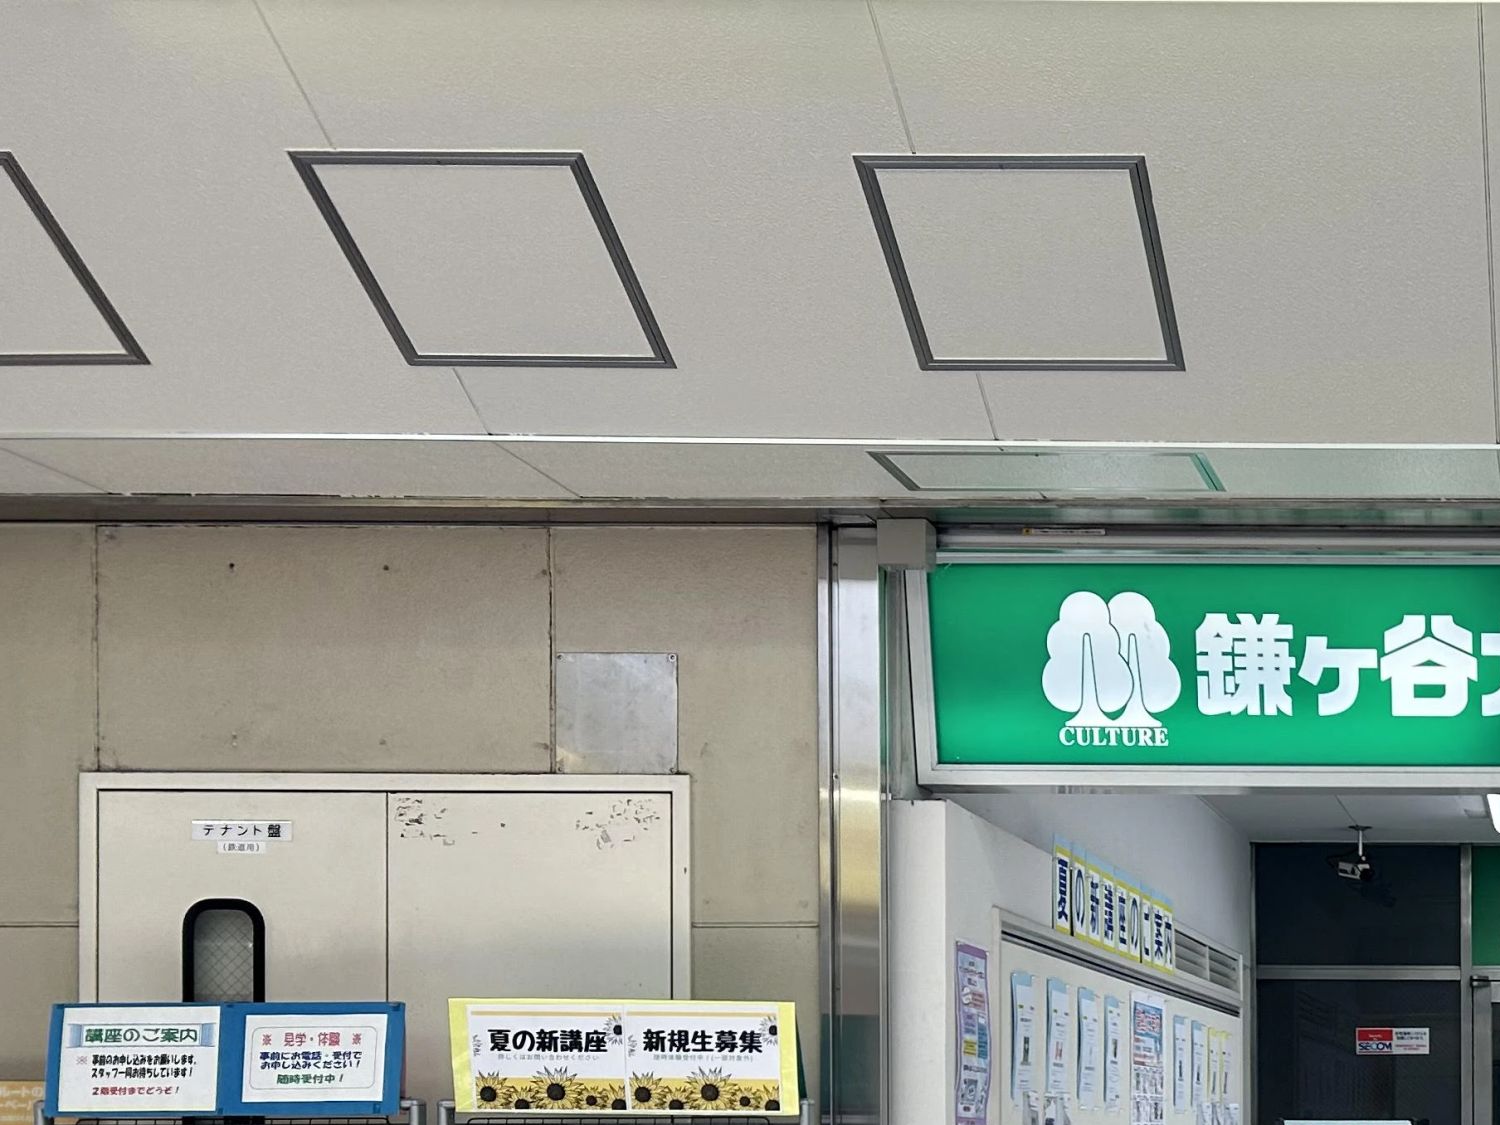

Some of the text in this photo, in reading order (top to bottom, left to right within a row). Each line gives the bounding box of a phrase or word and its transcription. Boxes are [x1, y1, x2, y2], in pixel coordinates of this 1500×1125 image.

[1059, 727, 1169, 747] CULTURE
[203, 824, 281, 838] テナント盤
[85, 1028, 198, 1043] 講座のご案内
[487, 1028, 608, 1053] 夏の新講座
[643, 1029, 763, 1053] 新規生募集
